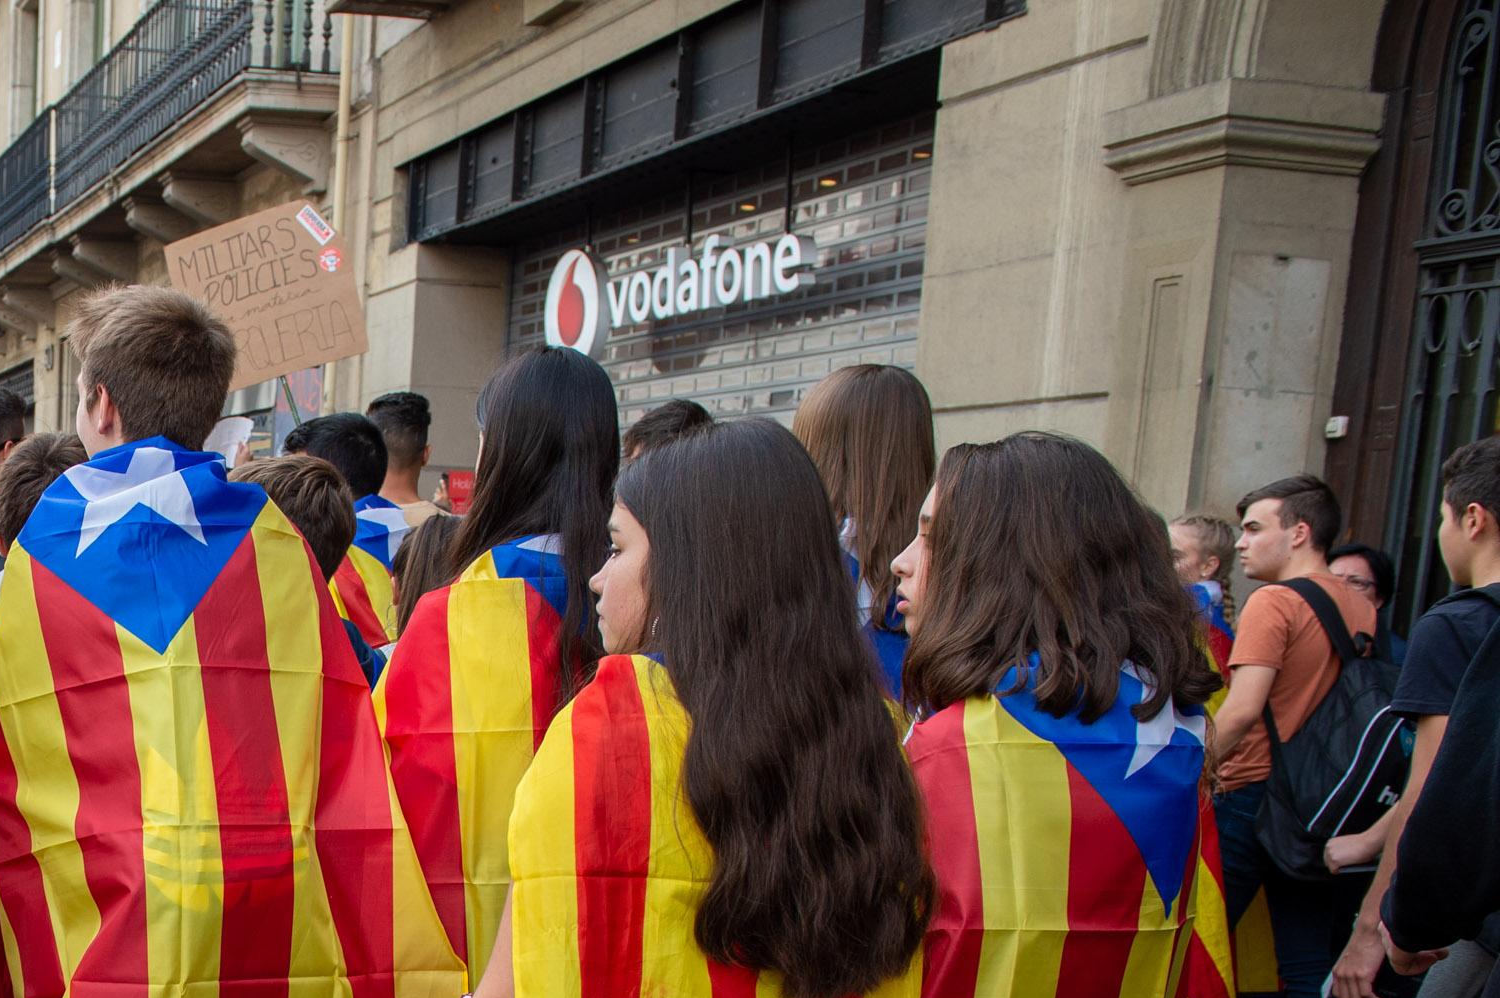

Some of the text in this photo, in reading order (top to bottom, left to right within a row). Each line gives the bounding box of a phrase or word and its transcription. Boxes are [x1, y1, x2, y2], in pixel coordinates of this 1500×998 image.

[178, 217, 297, 287] MILITARS
[204, 249, 319, 307] POLICIES
[606, 234, 802, 328] vodafone
